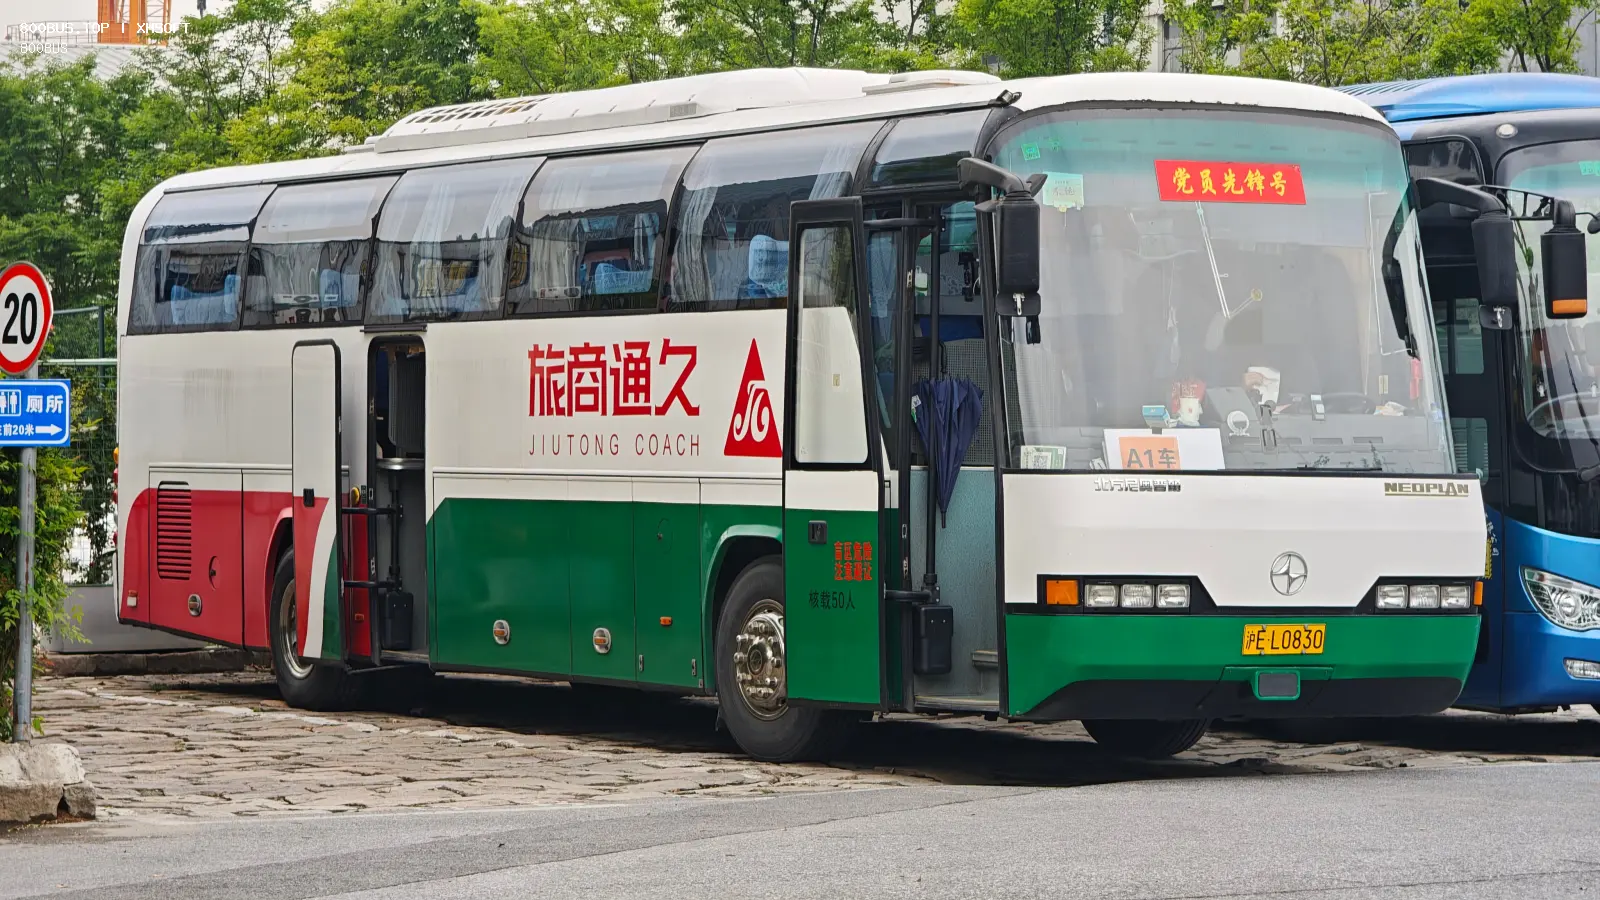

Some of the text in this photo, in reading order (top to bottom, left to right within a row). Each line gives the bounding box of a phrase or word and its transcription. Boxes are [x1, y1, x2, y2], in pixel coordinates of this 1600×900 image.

[1172, 167, 1287, 197] 党员先锋号
[2, 292, 38, 345] 20
[25, 394, 64, 414] 厕所
[528, 433, 700, 456] JIUTONG COACH
[1126, 447, 1177, 469] A1车
[1384, 482, 1469, 496] NEOPLAN
[833, 541, 873, 561] 盲区危险
[808, 588, 856, 612] 核载50人
